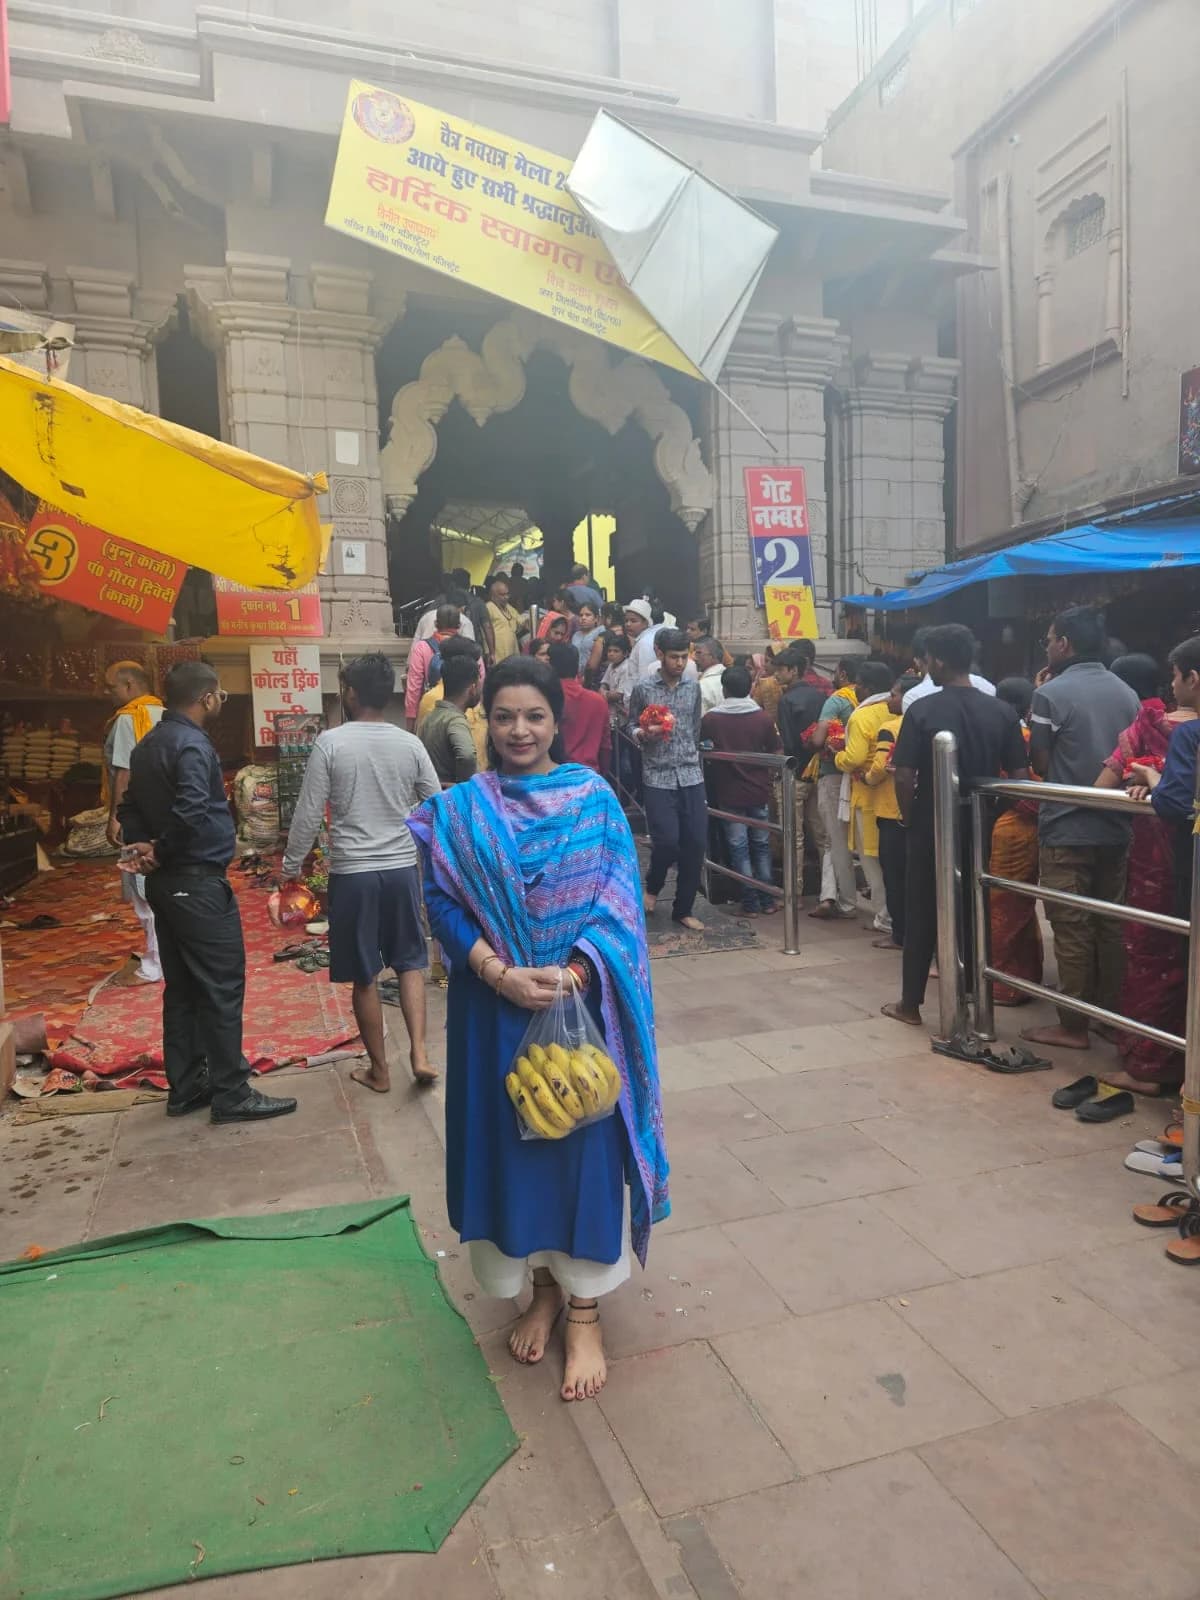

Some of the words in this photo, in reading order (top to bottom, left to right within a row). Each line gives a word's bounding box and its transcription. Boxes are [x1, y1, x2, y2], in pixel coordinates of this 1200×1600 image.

[440, 121, 463, 150] चैत्र
[465, 136, 509, 170] नवरात्र
[513, 151, 553, 187] मेला
[407, 147, 448, 178] आये
[451, 163, 478, 190] हुए
[481, 175, 519, 206] सभी
[365, 165, 472, 225] हार्दिक
[480, 212, 584, 274] स्वागत
[760, 474, 793, 504] गेट
[752, 504, 804, 530] नम्बर
[764, 537, 804, 587] 2
[284, 597, 302, 621] 1
[784, 604, 804, 637] 2
[252, 668, 289, 689] कोल्ड
[291, 667, 320, 692] ड्रिंक
[280, 692, 293, 704] व
